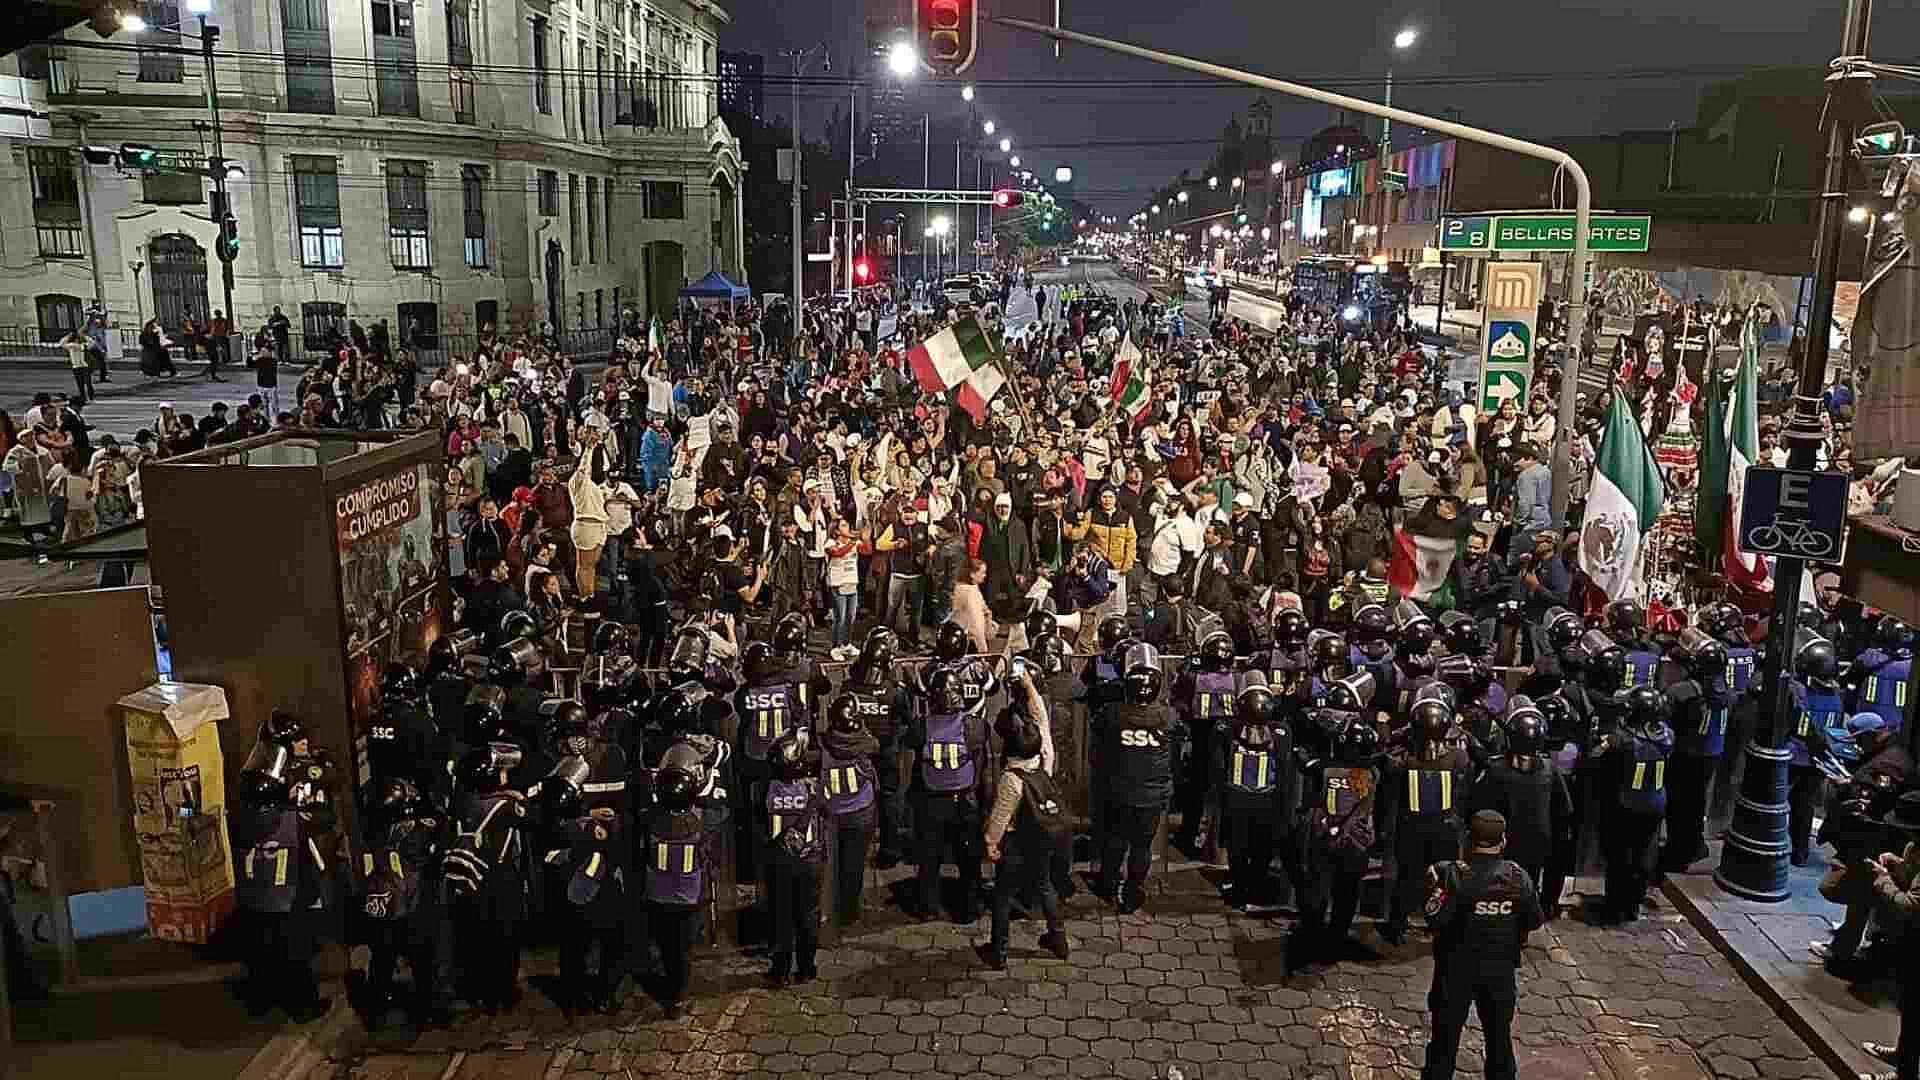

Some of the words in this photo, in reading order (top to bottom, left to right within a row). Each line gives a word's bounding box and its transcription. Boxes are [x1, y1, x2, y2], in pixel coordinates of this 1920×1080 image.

[1448, 220, 1464, 235] 2
[1501, 227, 1573, 241] BELLAS
[1470, 231, 1484, 246] 8
[337, 471, 416, 518] COMPROMISO
[1779, 473, 1812, 507] E
[350, 498, 409, 539] CUMPLIDO
[745, 693, 785, 710] SSC
[773, 796, 807, 809] SSC
[1474, 900, 1513, 915] SSC
